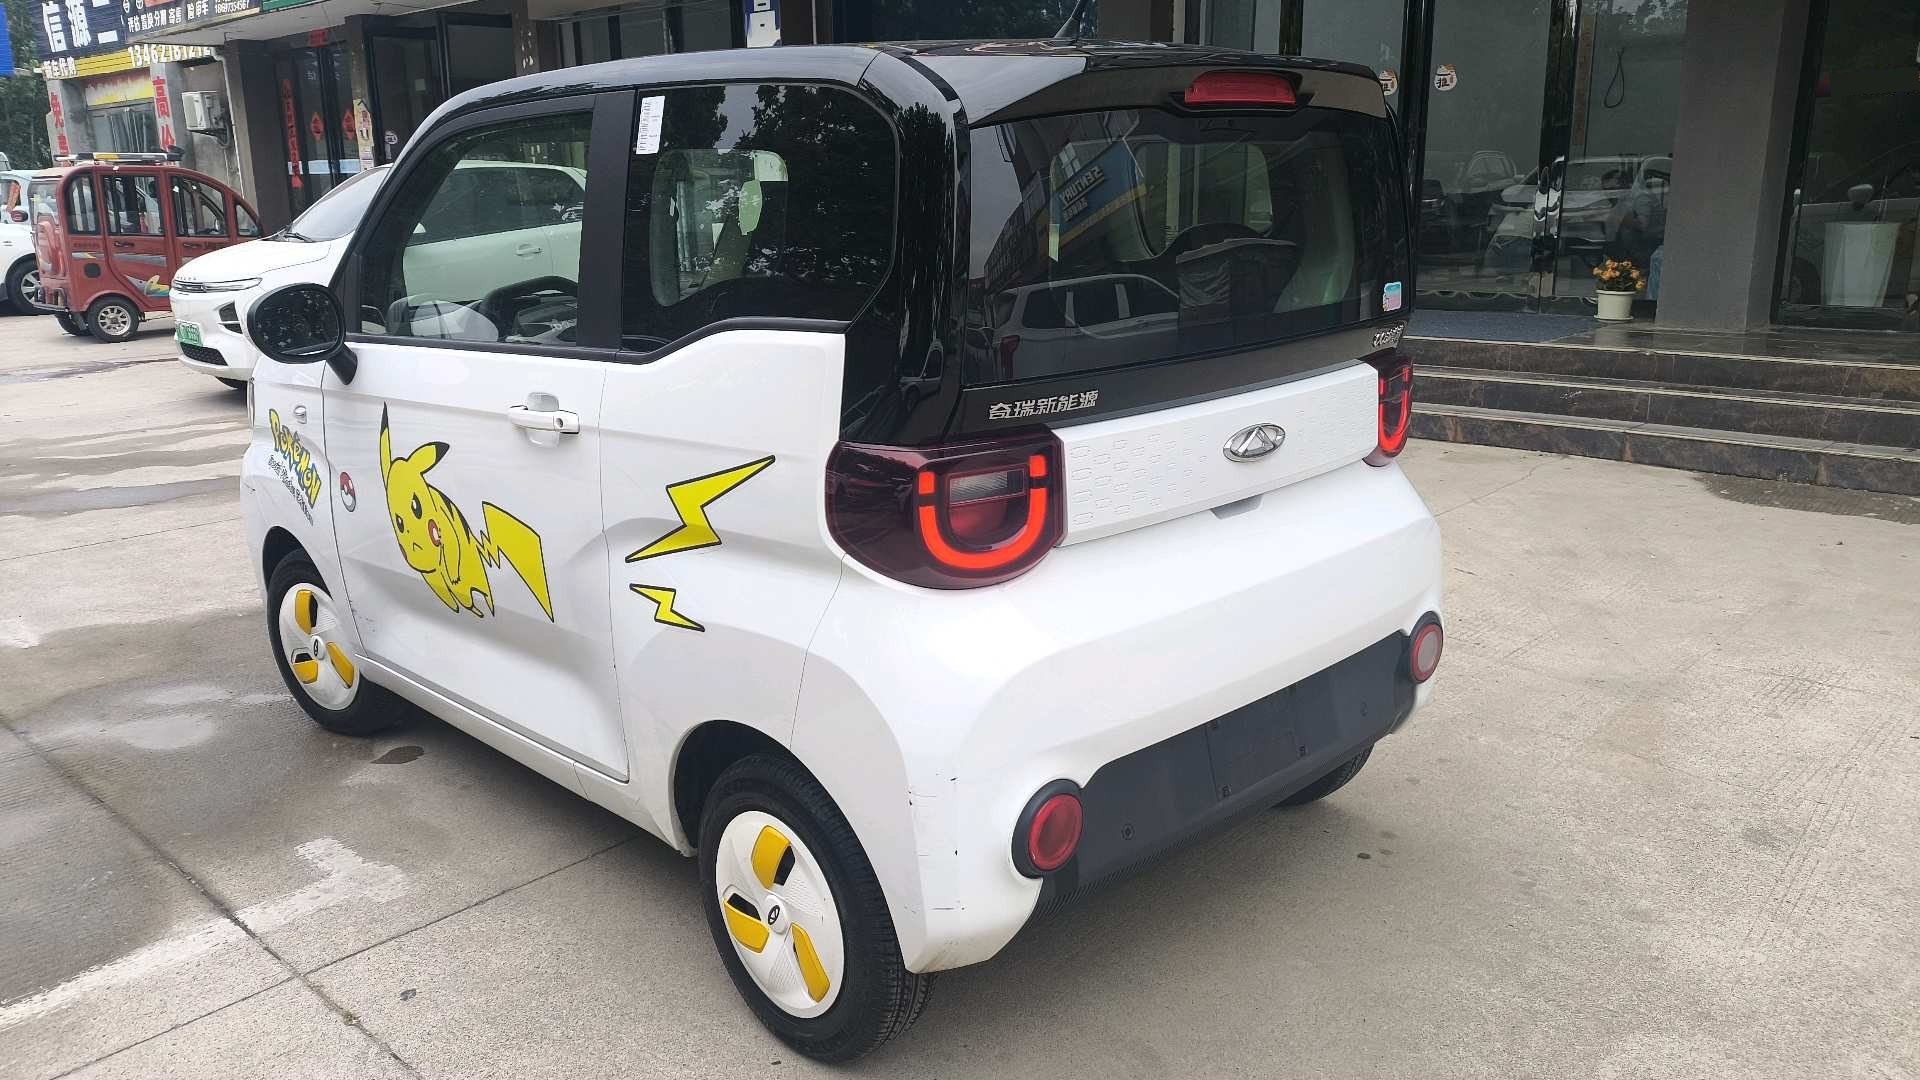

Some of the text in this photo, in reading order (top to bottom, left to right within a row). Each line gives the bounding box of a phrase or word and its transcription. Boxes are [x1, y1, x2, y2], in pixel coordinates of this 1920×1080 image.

[988, 389, 1099, 420] 奇瑞新能源
